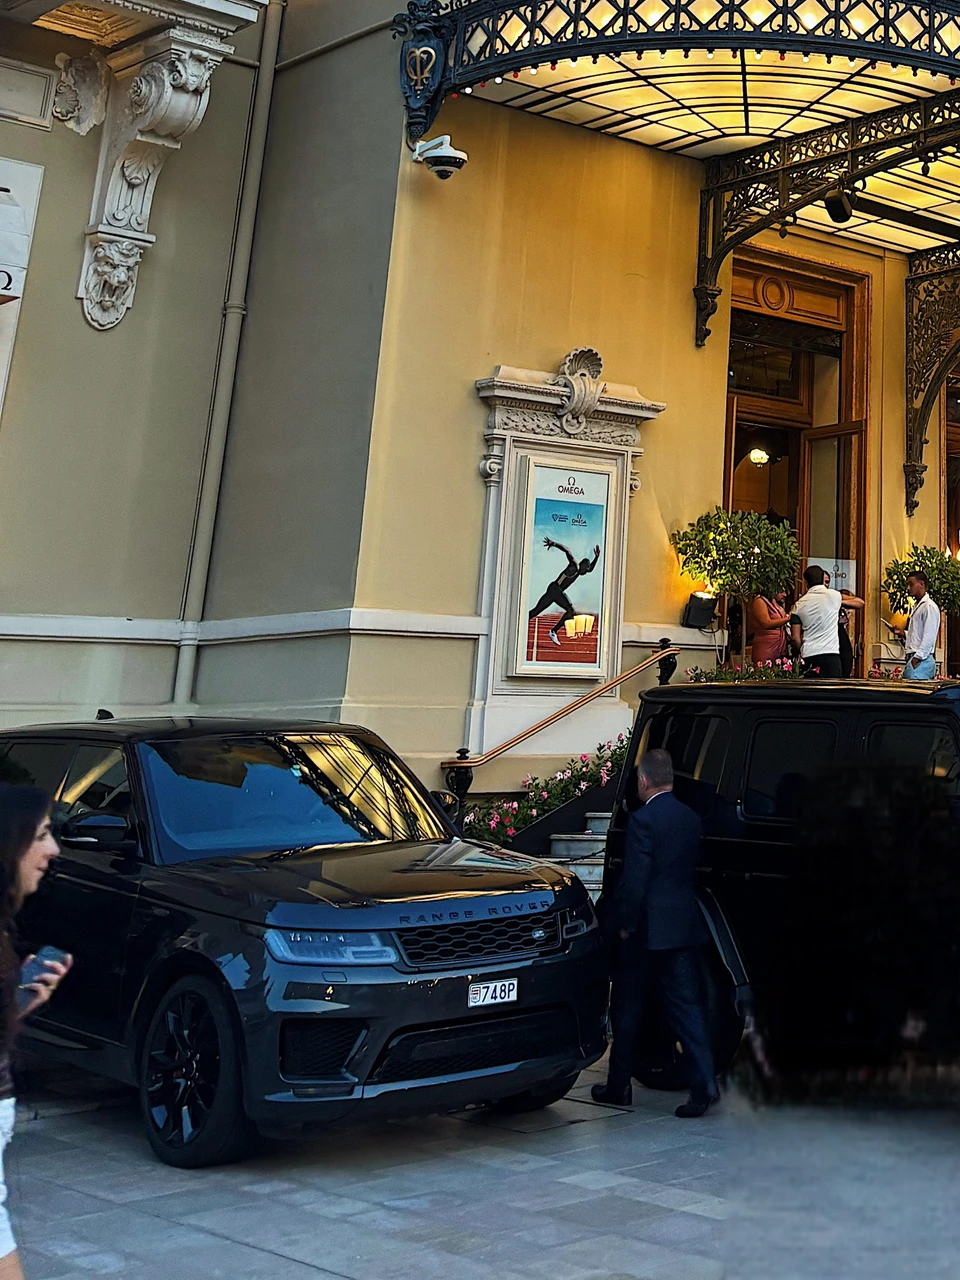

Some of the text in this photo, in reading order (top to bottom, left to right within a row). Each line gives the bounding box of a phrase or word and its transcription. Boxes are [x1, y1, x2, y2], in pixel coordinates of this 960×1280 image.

[557, 485, 585, 496] OMEGA
[399, 900, 551, 924] RANGE ROVER
[481, 982, 516, 1003] 748P
